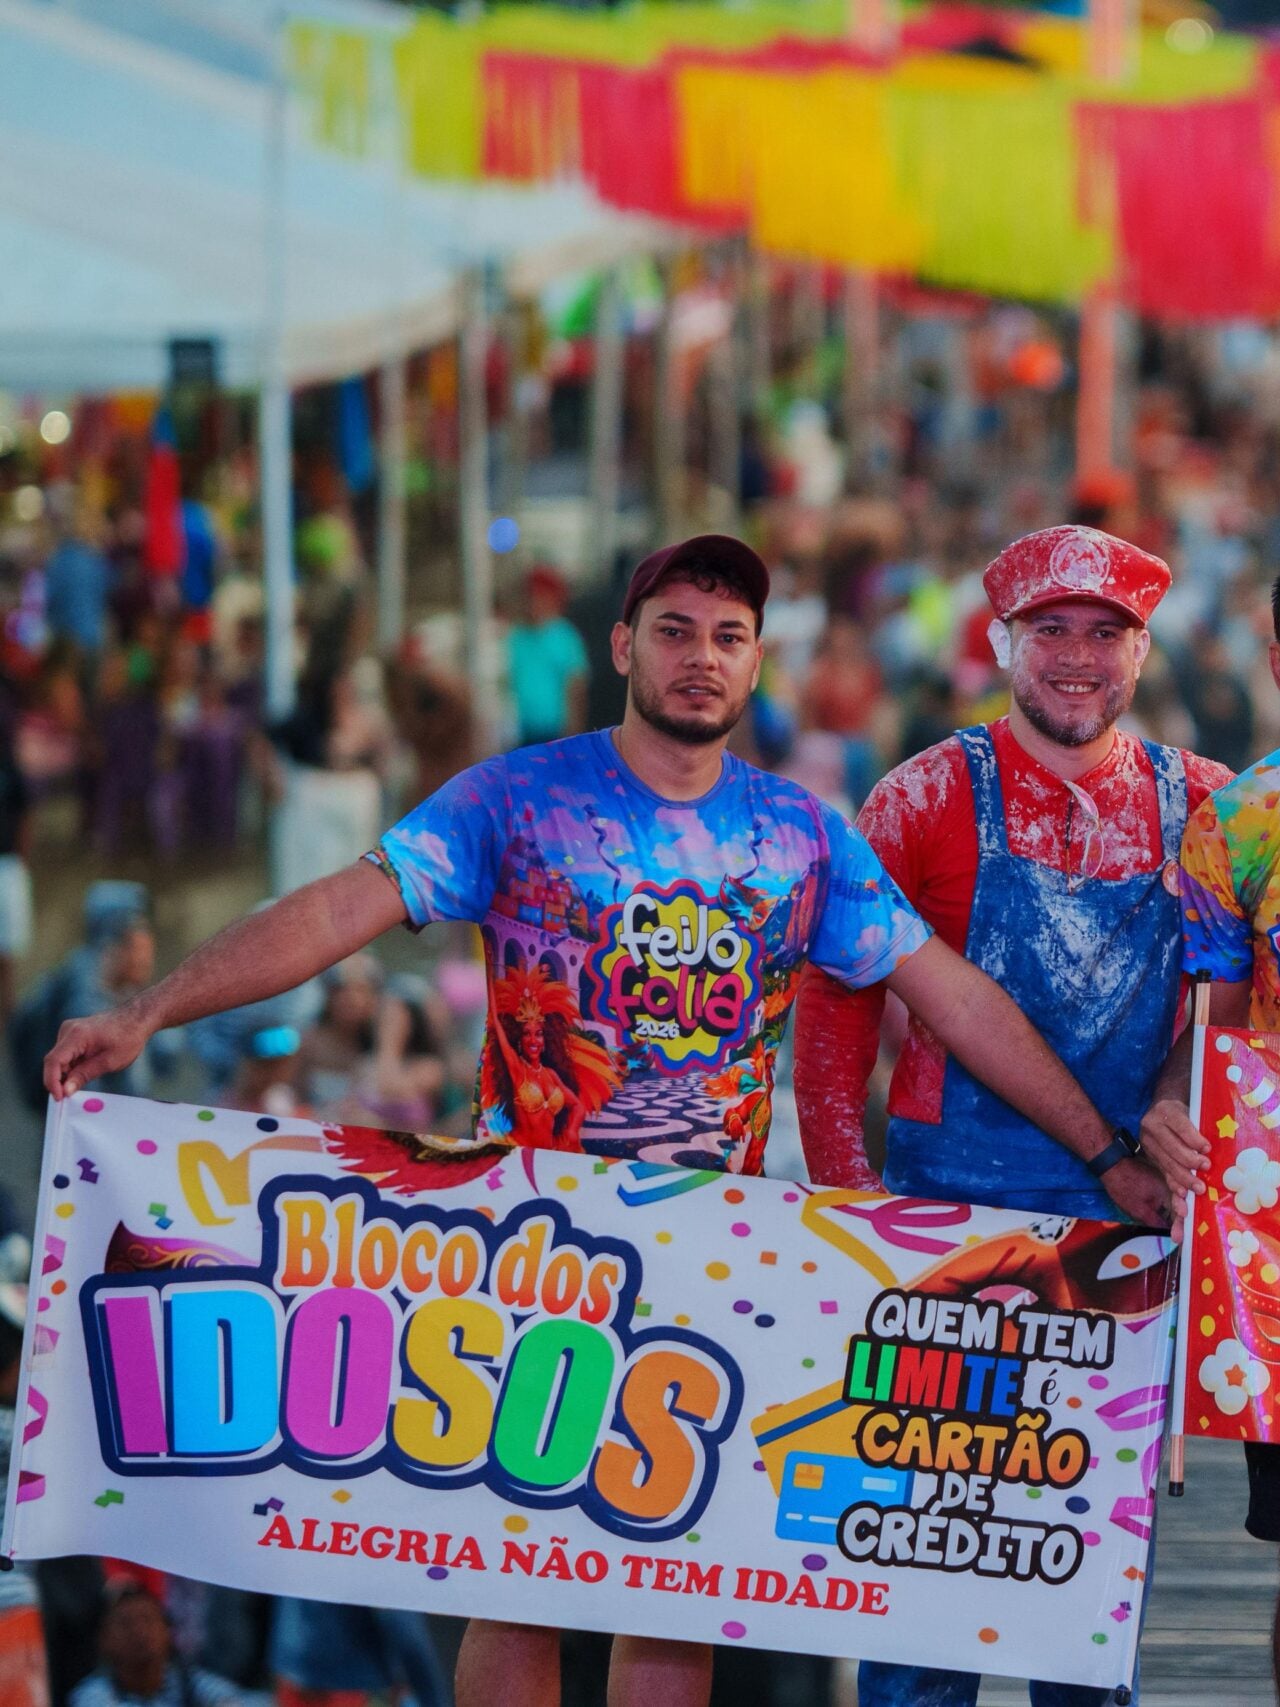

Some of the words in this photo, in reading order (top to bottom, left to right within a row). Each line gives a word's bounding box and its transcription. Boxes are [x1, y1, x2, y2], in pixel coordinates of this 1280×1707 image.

[635, 1020, 680, 1039] 2026
[280, 1196, 479, 1298] Bloco
[499, 1222, 622, 1324] dos
[871, 1294, 999, 1351] QUEM
[1018, 1311, 1112, 1364] TEM
[103, 1287, 721, 1519] IDOSOS
[849, 1341, 1023, 1417] LIMITE
[1038, 1367, 1060, 1406] é
[861, 1412, 1085, 1489] CARTÃO
[937, 1473, 993, 1513] DE
[258, 1514, 487, 1572] ALEGRIA
[499, 1536, 610, 1585] NÃO
[621, 1555, 722, 1598] TEM
[732, 1567, 891, 1616] IDADE
[841, 1499, 1079, 1581] CRÉDITO
